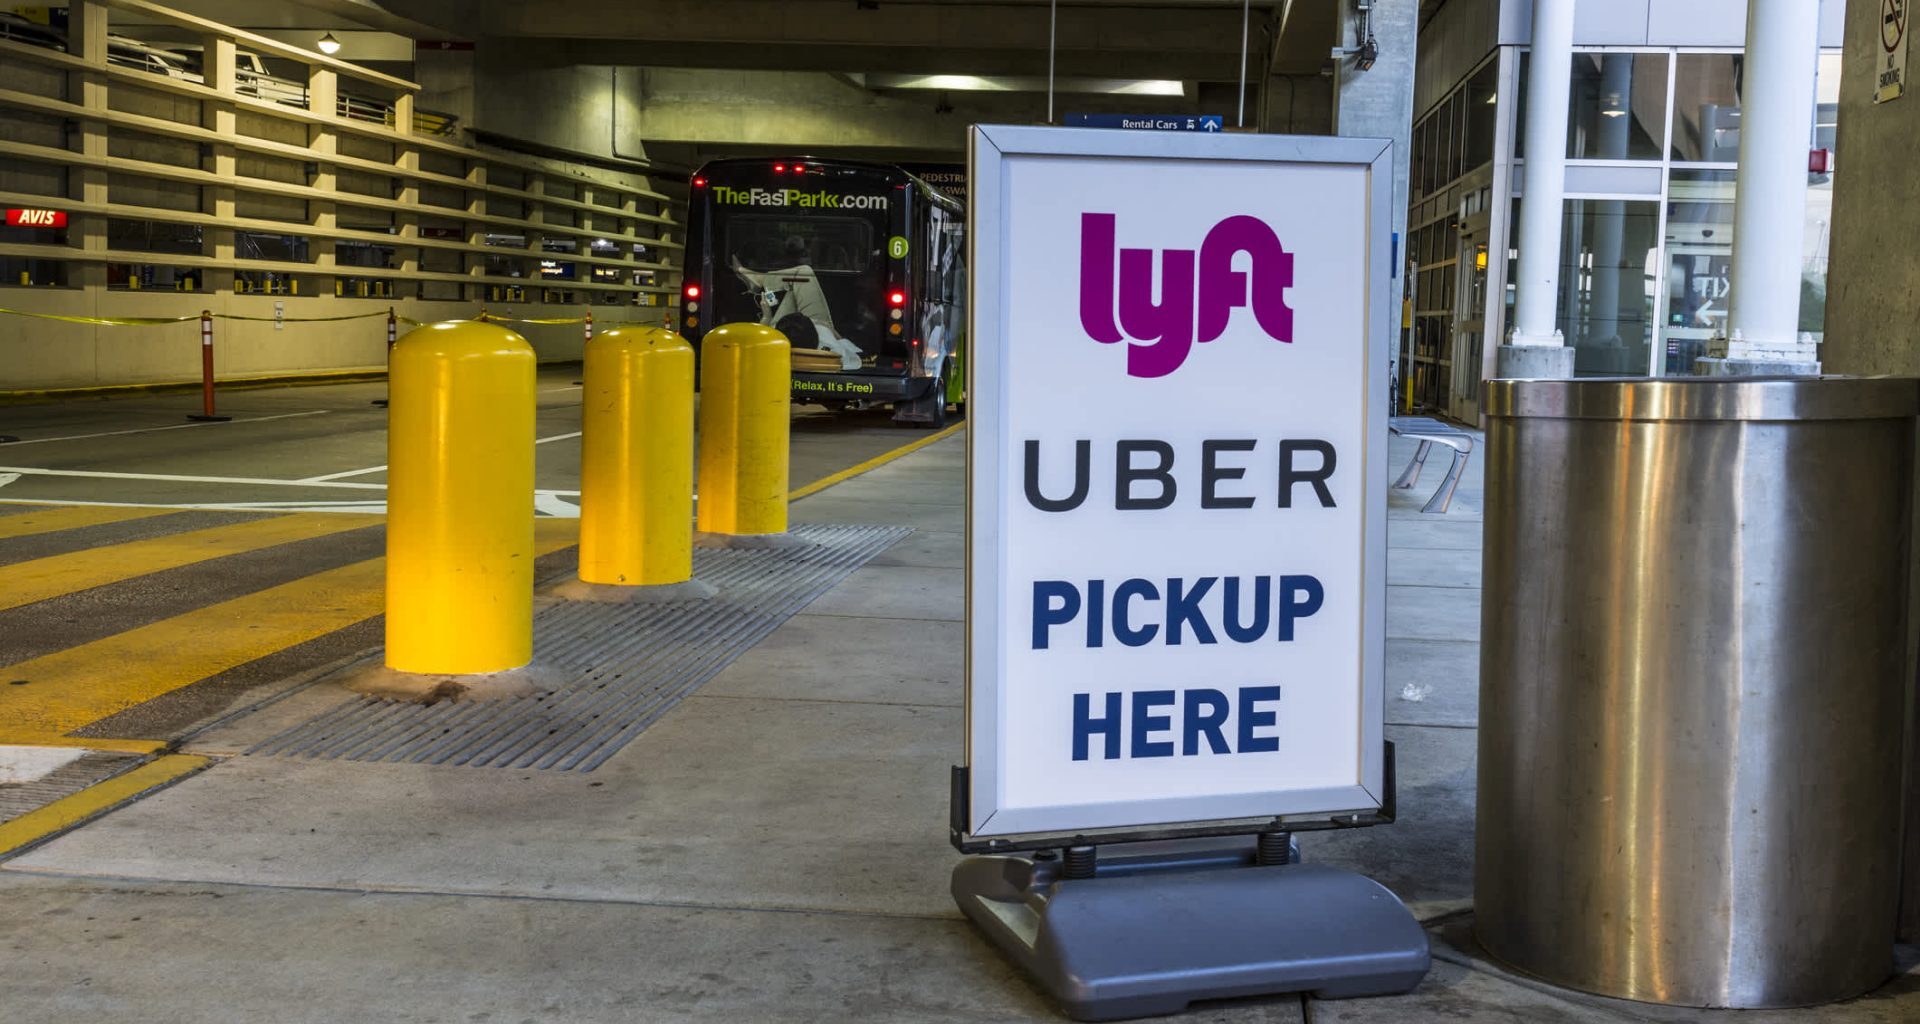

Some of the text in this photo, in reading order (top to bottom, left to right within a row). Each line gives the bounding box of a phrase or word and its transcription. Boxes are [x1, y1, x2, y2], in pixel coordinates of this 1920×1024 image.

[1887, 54, 1895, 69] NO
[1122, 119, 1178, 130] Rental Cars
[18, 209, 56, 225] AVIS
[893, 240, 903, 256] 6
[1079, 212, 1294, 378] lyft
[828, 381, 844, 392] It's
[846, 382, 873, 394] Free)
[1023, 438, 1338, 512] UBER
[1031, 574, 1324, 650] PICKUP
[1071, 685, 1281, 761] HERE
